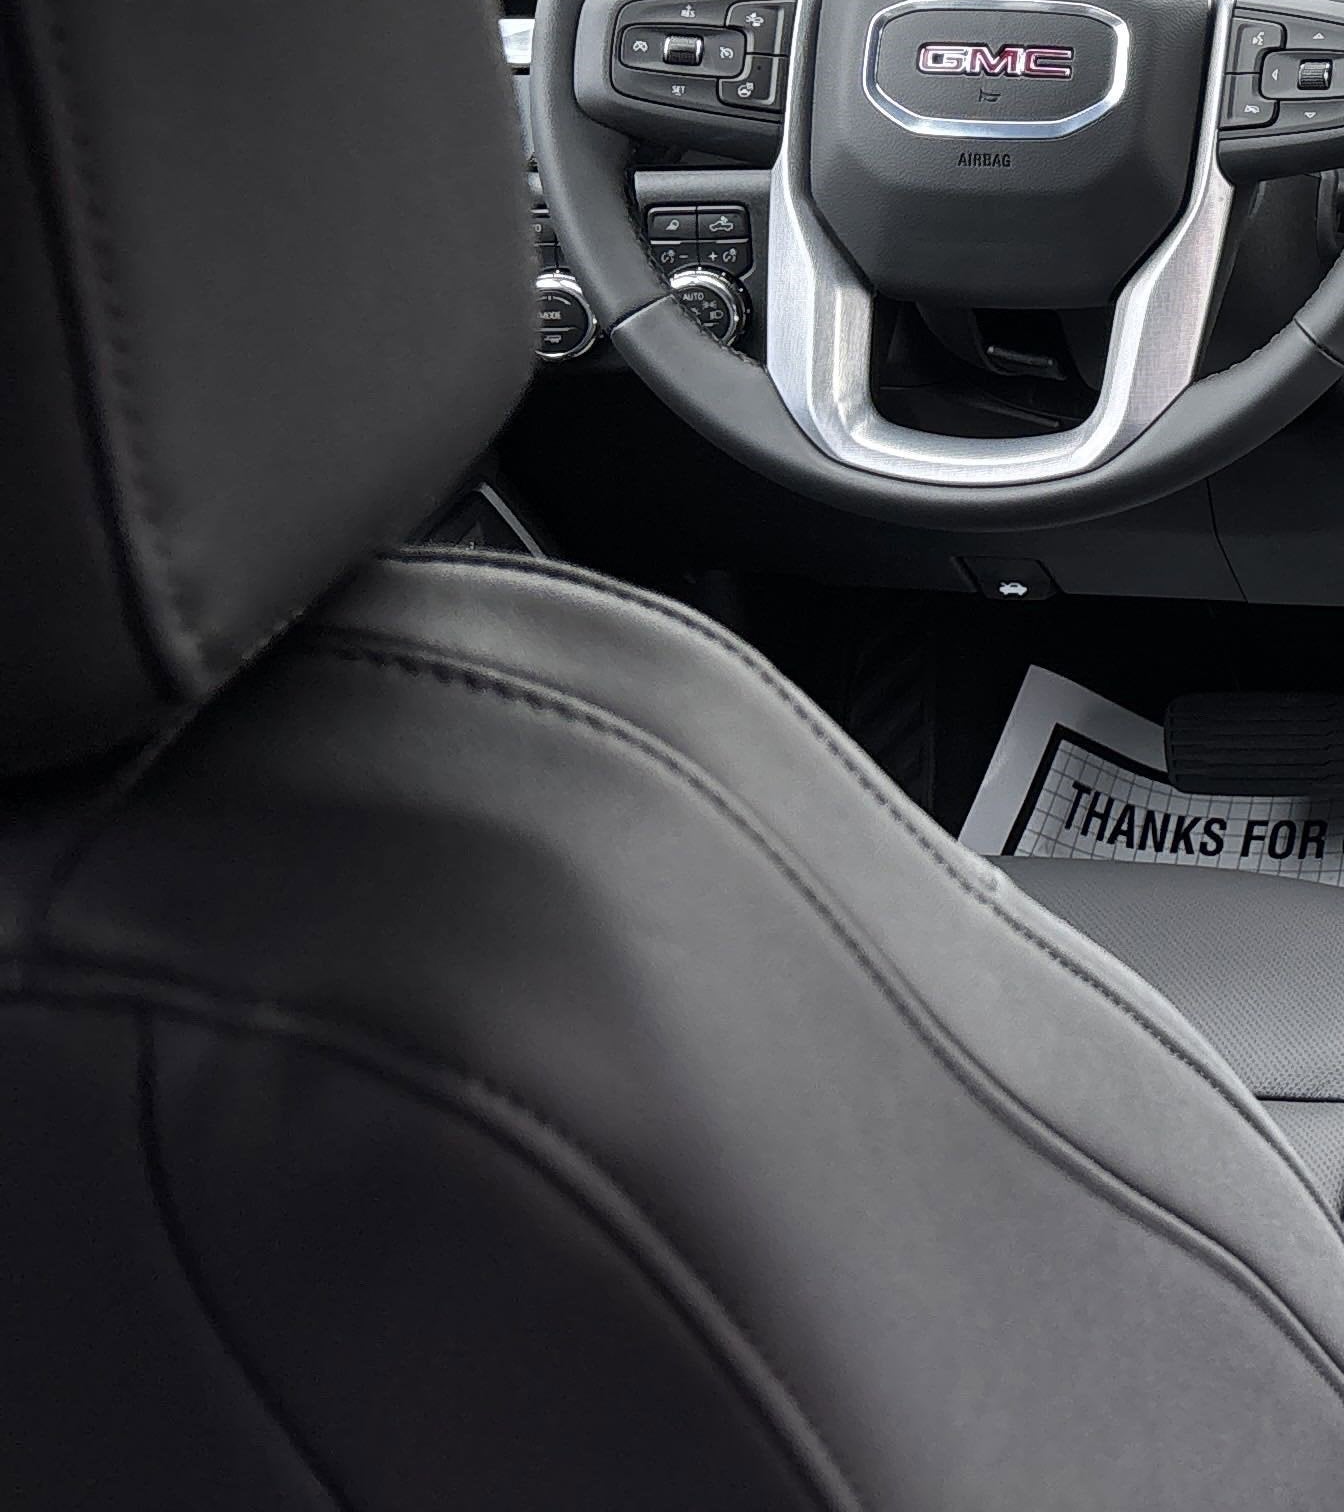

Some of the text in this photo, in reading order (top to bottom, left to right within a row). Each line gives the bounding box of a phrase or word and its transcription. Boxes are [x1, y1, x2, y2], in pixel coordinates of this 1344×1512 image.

[919, 43, 1074, 79] GMC
[958, 153, 1011, 167] AIRBAG
[683, 293, 704, 301] AUTO
[1064, 781, 1227, 857] THANKS
[1240, 819, 1329, 860] FOR
